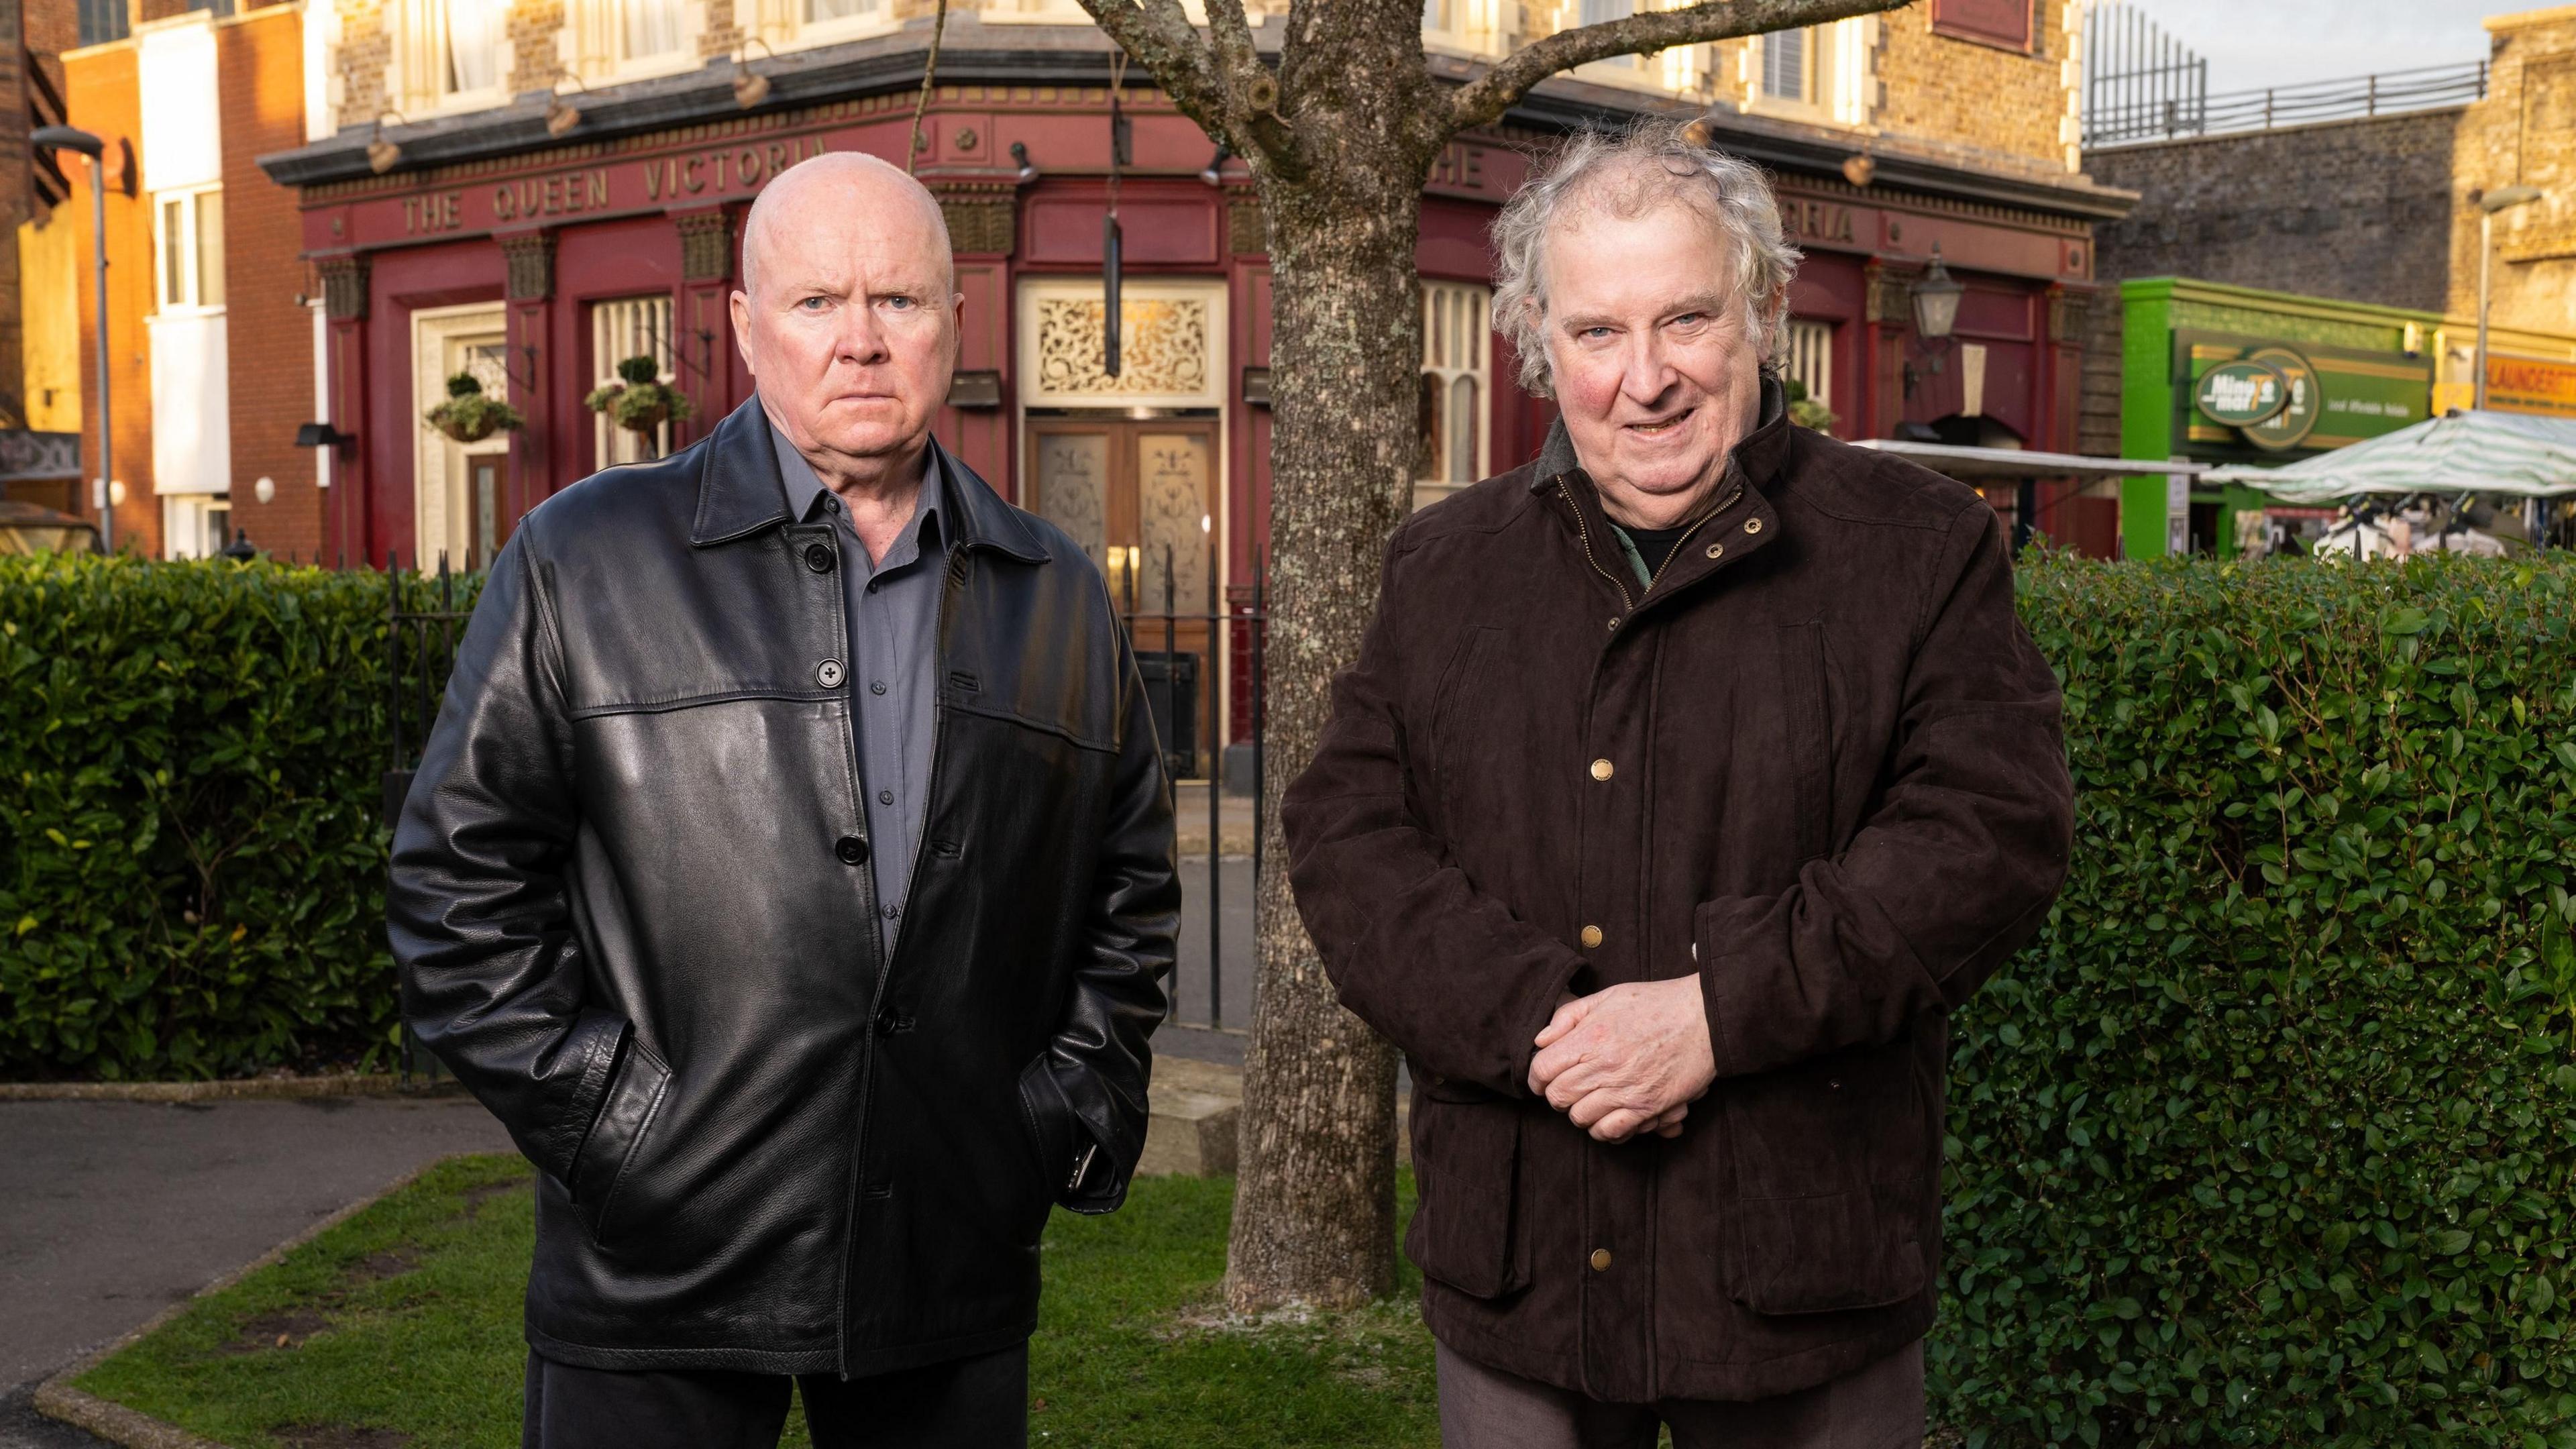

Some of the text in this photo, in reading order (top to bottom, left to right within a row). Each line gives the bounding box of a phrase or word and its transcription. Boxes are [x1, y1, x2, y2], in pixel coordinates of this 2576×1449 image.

[1429, 142, 1484, 189] HE
[402, 191, 462, 233] THE
[493, 170, 607, 222] QUEEN
